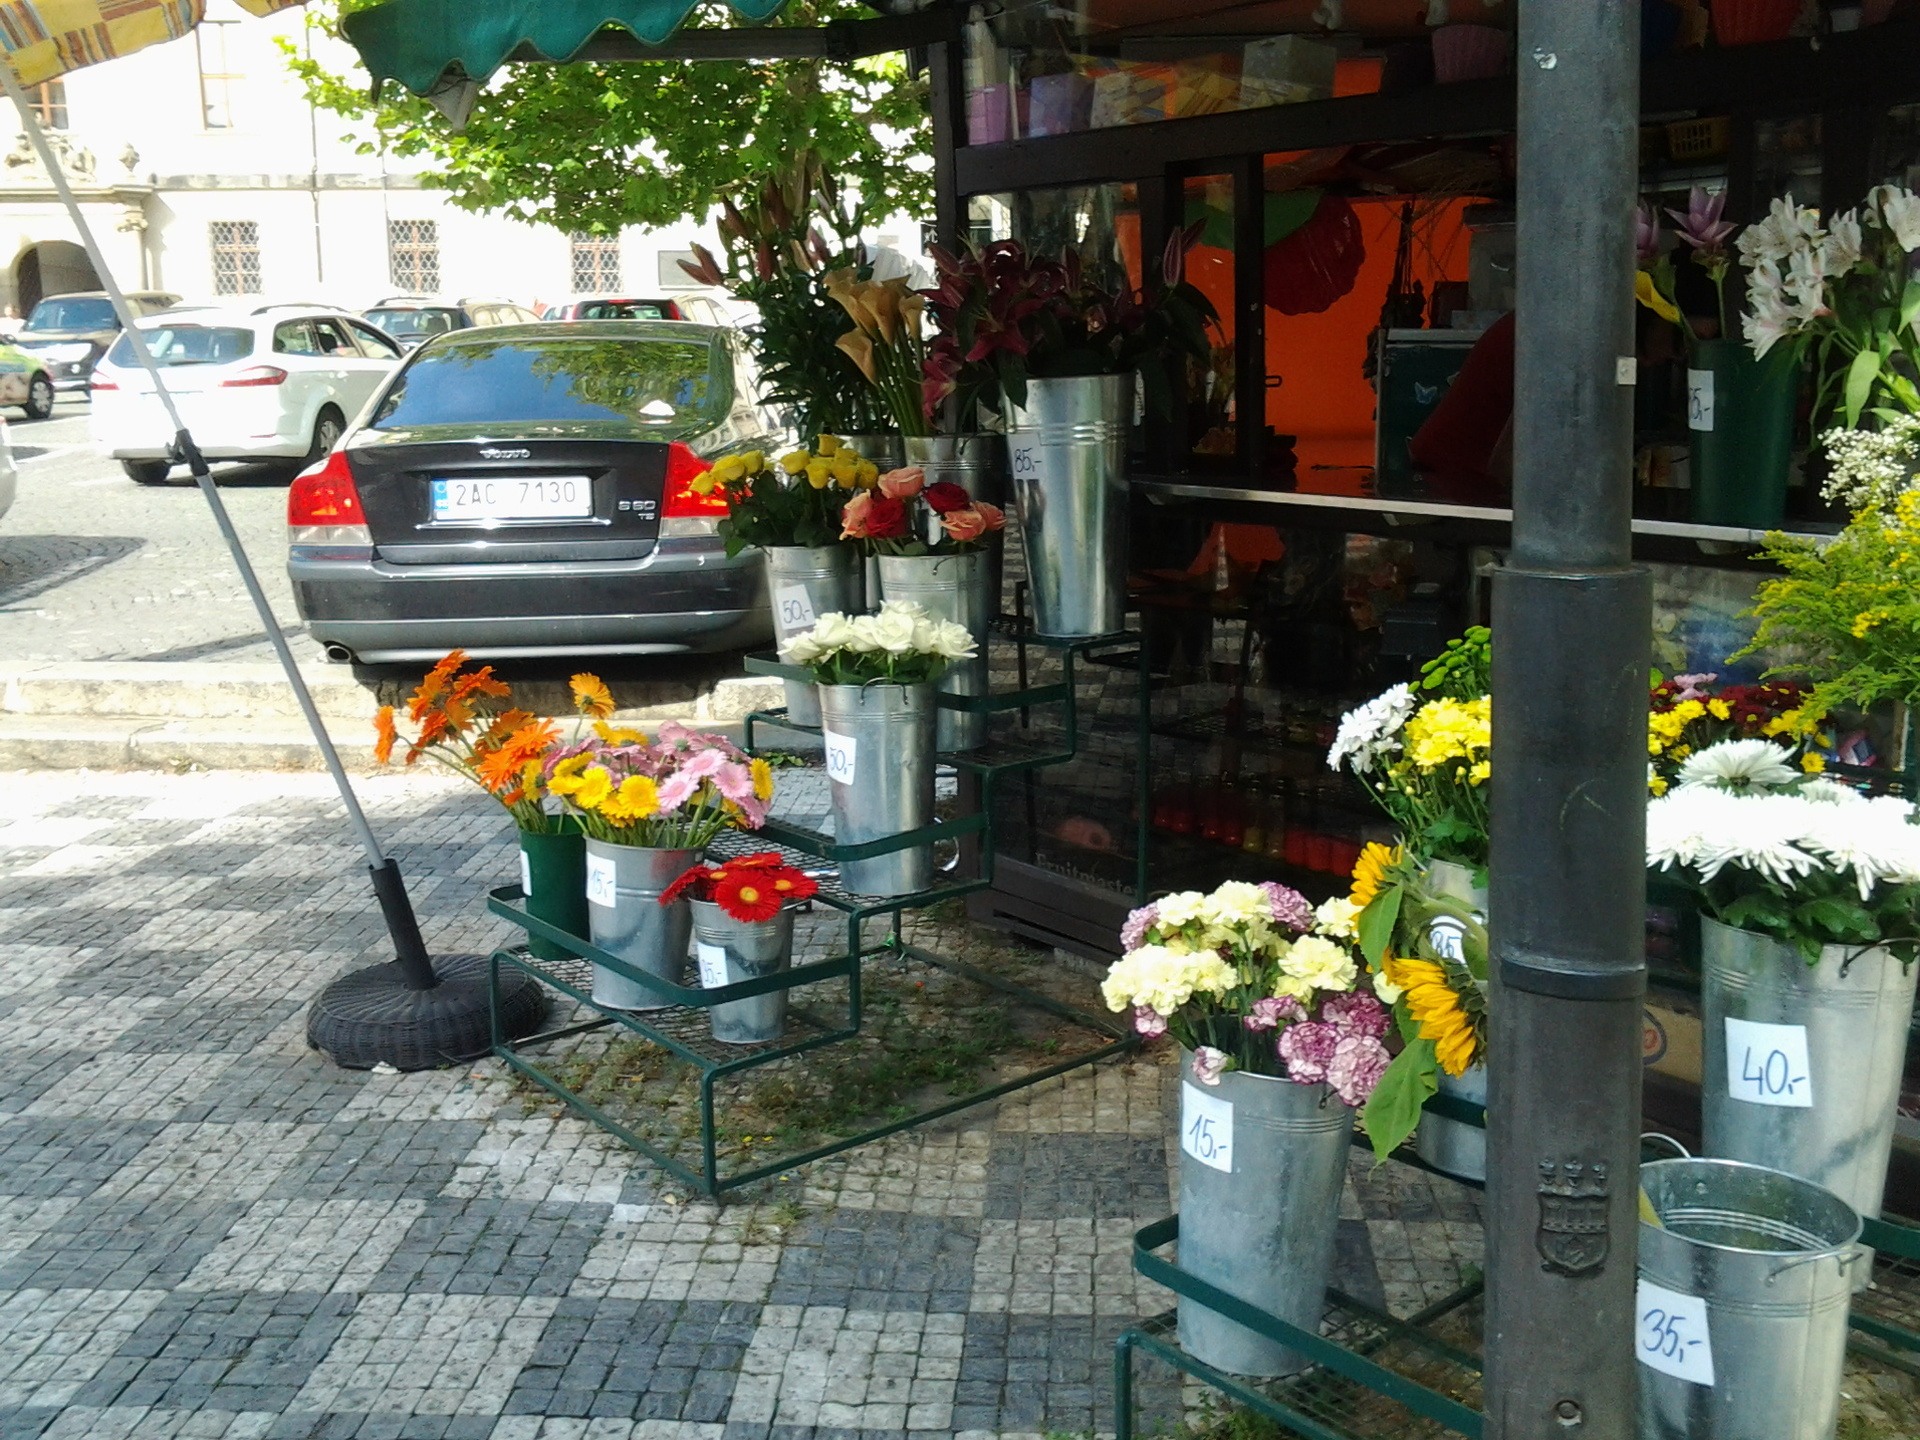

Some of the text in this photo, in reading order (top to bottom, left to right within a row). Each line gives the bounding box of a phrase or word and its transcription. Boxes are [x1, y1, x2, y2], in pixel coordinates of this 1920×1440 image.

[479, 448, 532, 459] VOLVO
[1014, 447, 1043, 473] 85,-
[456, 481, 577, 506] 2AC 7130
[782, 599, 811, 624] 50,-
[829, 746, 854, 775] 50,-
[591, 868, 614, 898] 15,-
[1743, 1046, 1806, 1095] 40,-
[1189, 1113, 1228, 1160] 15,-
[1642, 1308, 1703, 1364] 35,-
